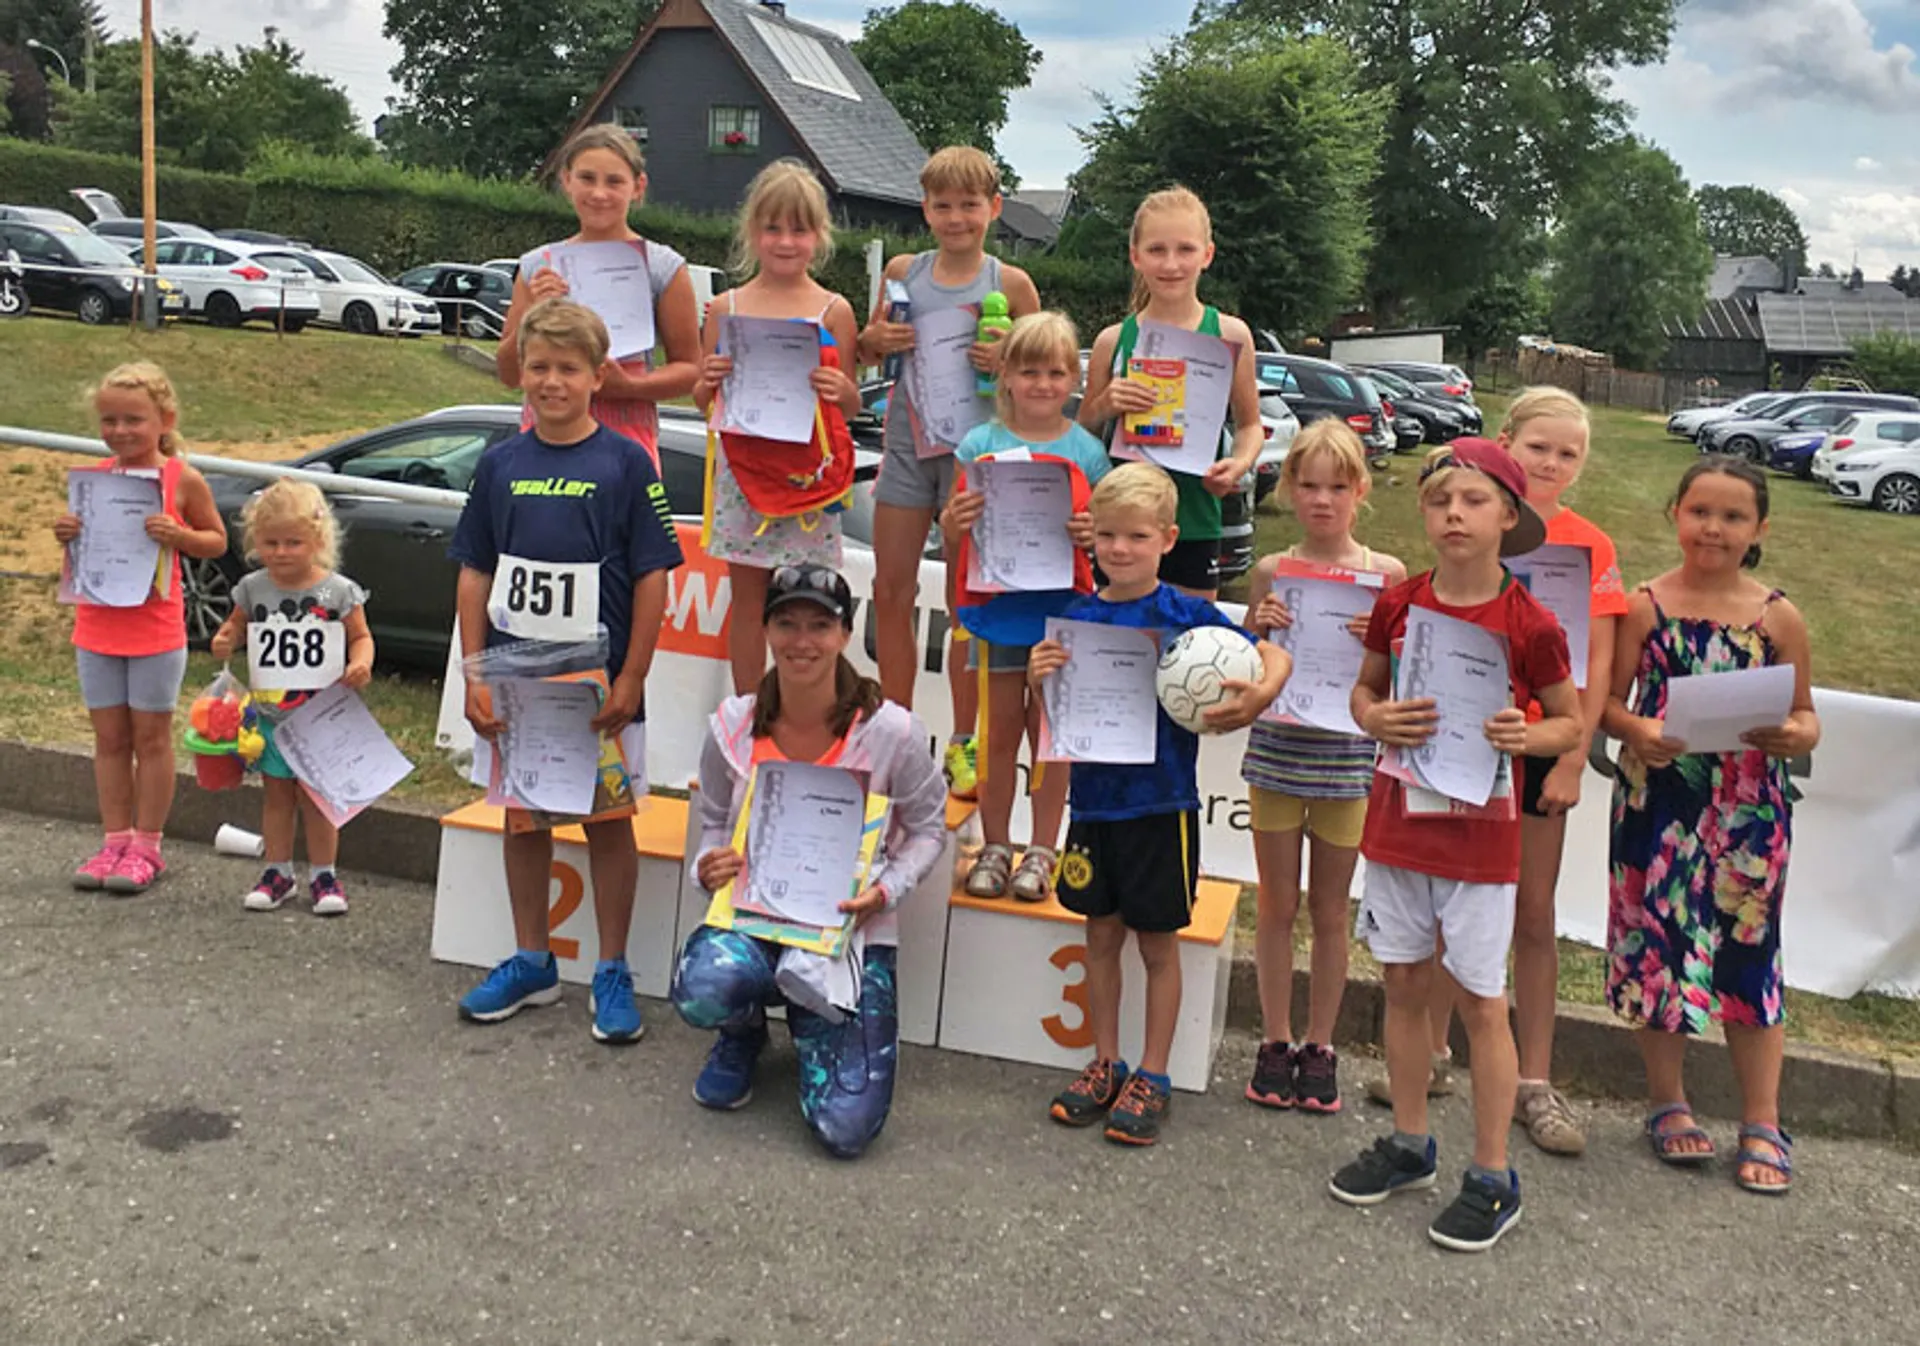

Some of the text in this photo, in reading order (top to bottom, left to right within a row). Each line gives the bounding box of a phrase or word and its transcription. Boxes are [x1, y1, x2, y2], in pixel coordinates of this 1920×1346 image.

[508, 566, 575, 617] 851
[259, 628, 325, 668] 268
[1207, 795, 1252, 830] ra
[548, 860, 584, 960] 2
[1040, 944, 1096, 1049] 3
